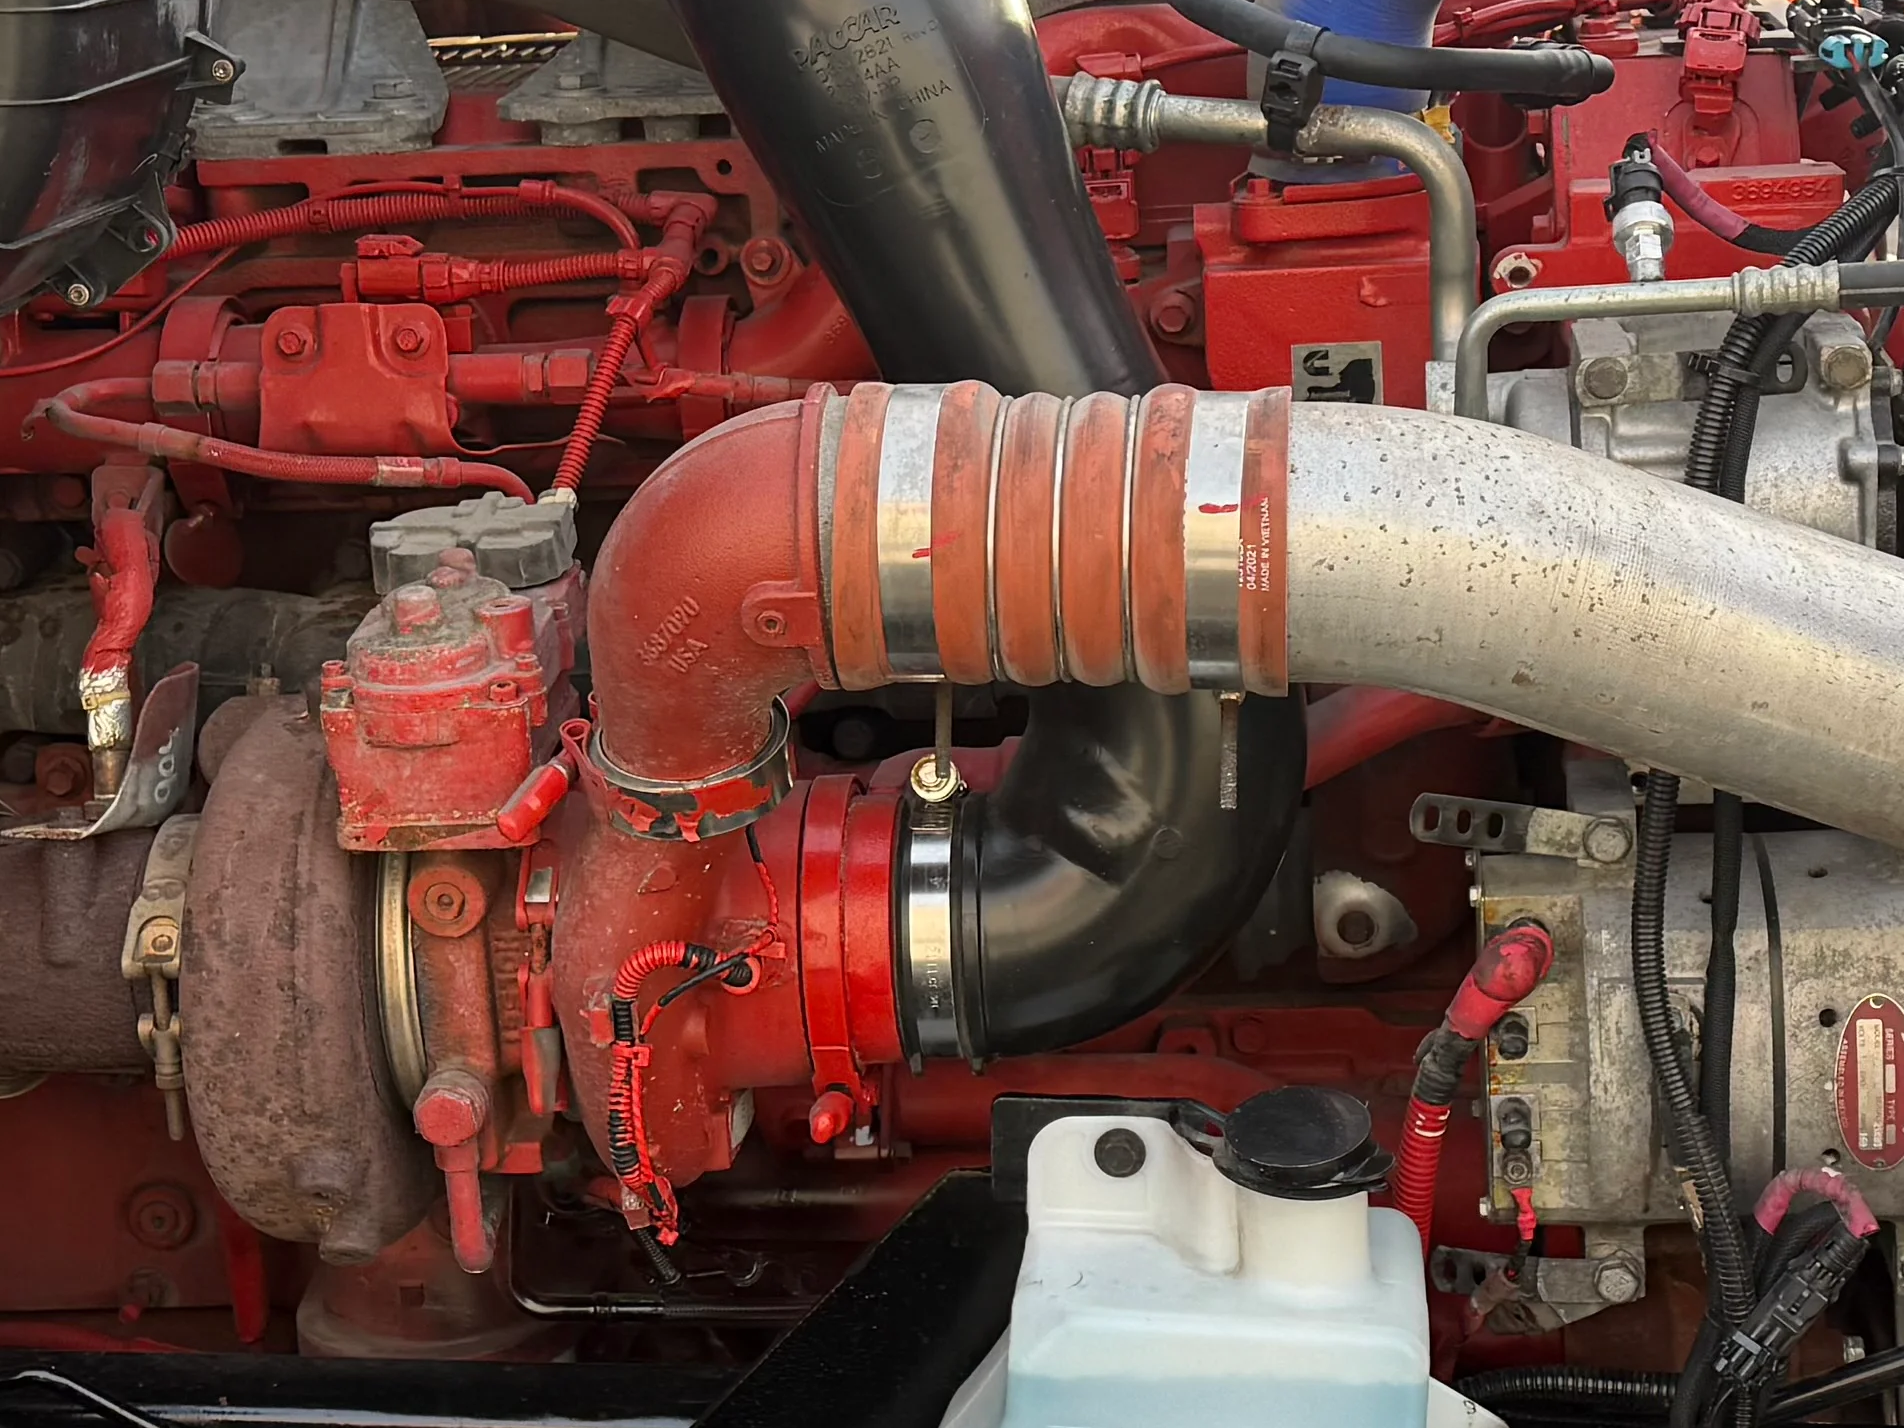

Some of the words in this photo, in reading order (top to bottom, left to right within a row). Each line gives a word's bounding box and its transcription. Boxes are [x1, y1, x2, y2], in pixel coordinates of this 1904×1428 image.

[791, 4, 901, 67] PACCAR
[1260, 497, 1270, 546] VIETNAM
[1246, 544, 1257, 590] 04/2021
[1261, 548, 1269, 559] IN
[1261, 561, 1269, 591] MADE
[667, 638, 709, 673] USA
